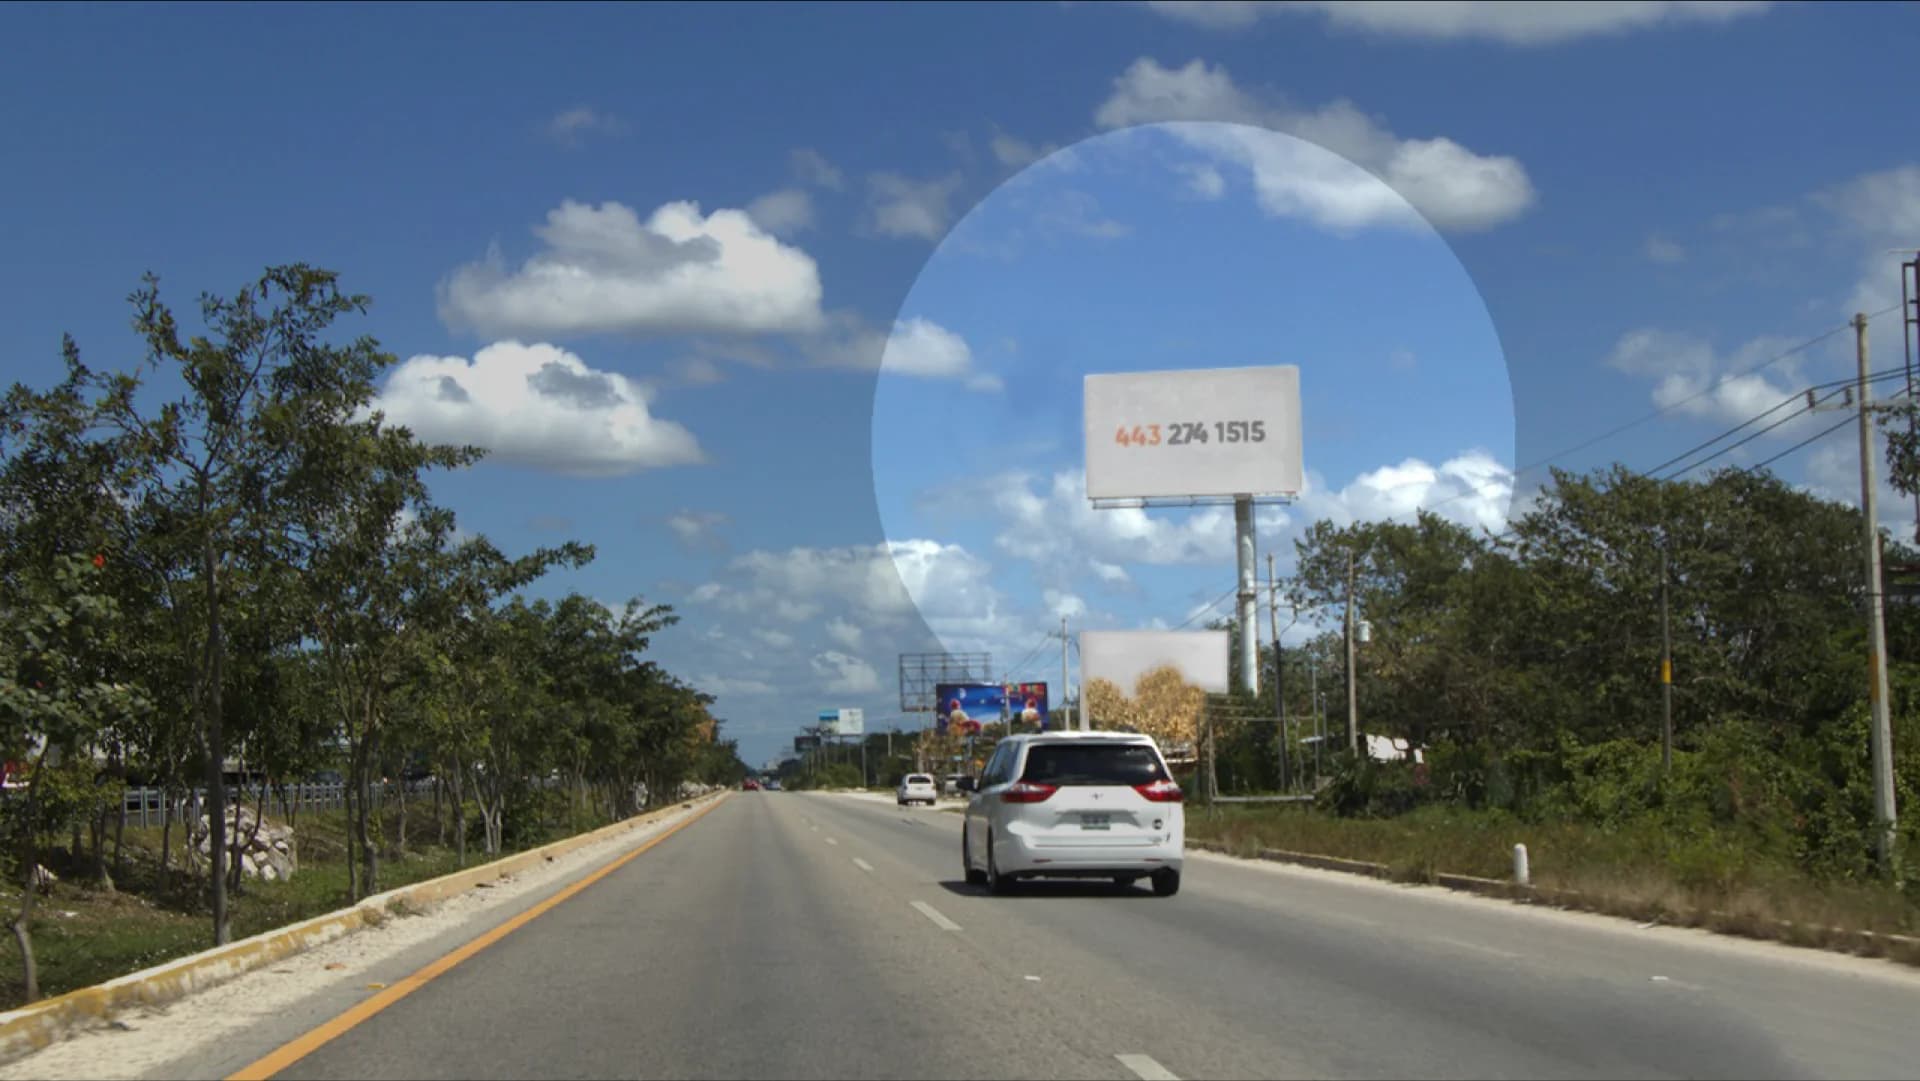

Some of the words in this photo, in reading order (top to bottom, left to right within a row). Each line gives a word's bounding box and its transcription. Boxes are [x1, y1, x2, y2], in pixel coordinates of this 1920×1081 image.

[1115, 424, 1161, 447] 443
[1167, 422, 1209, 445] 274
[1214, 420, 1266, 443] 1515
